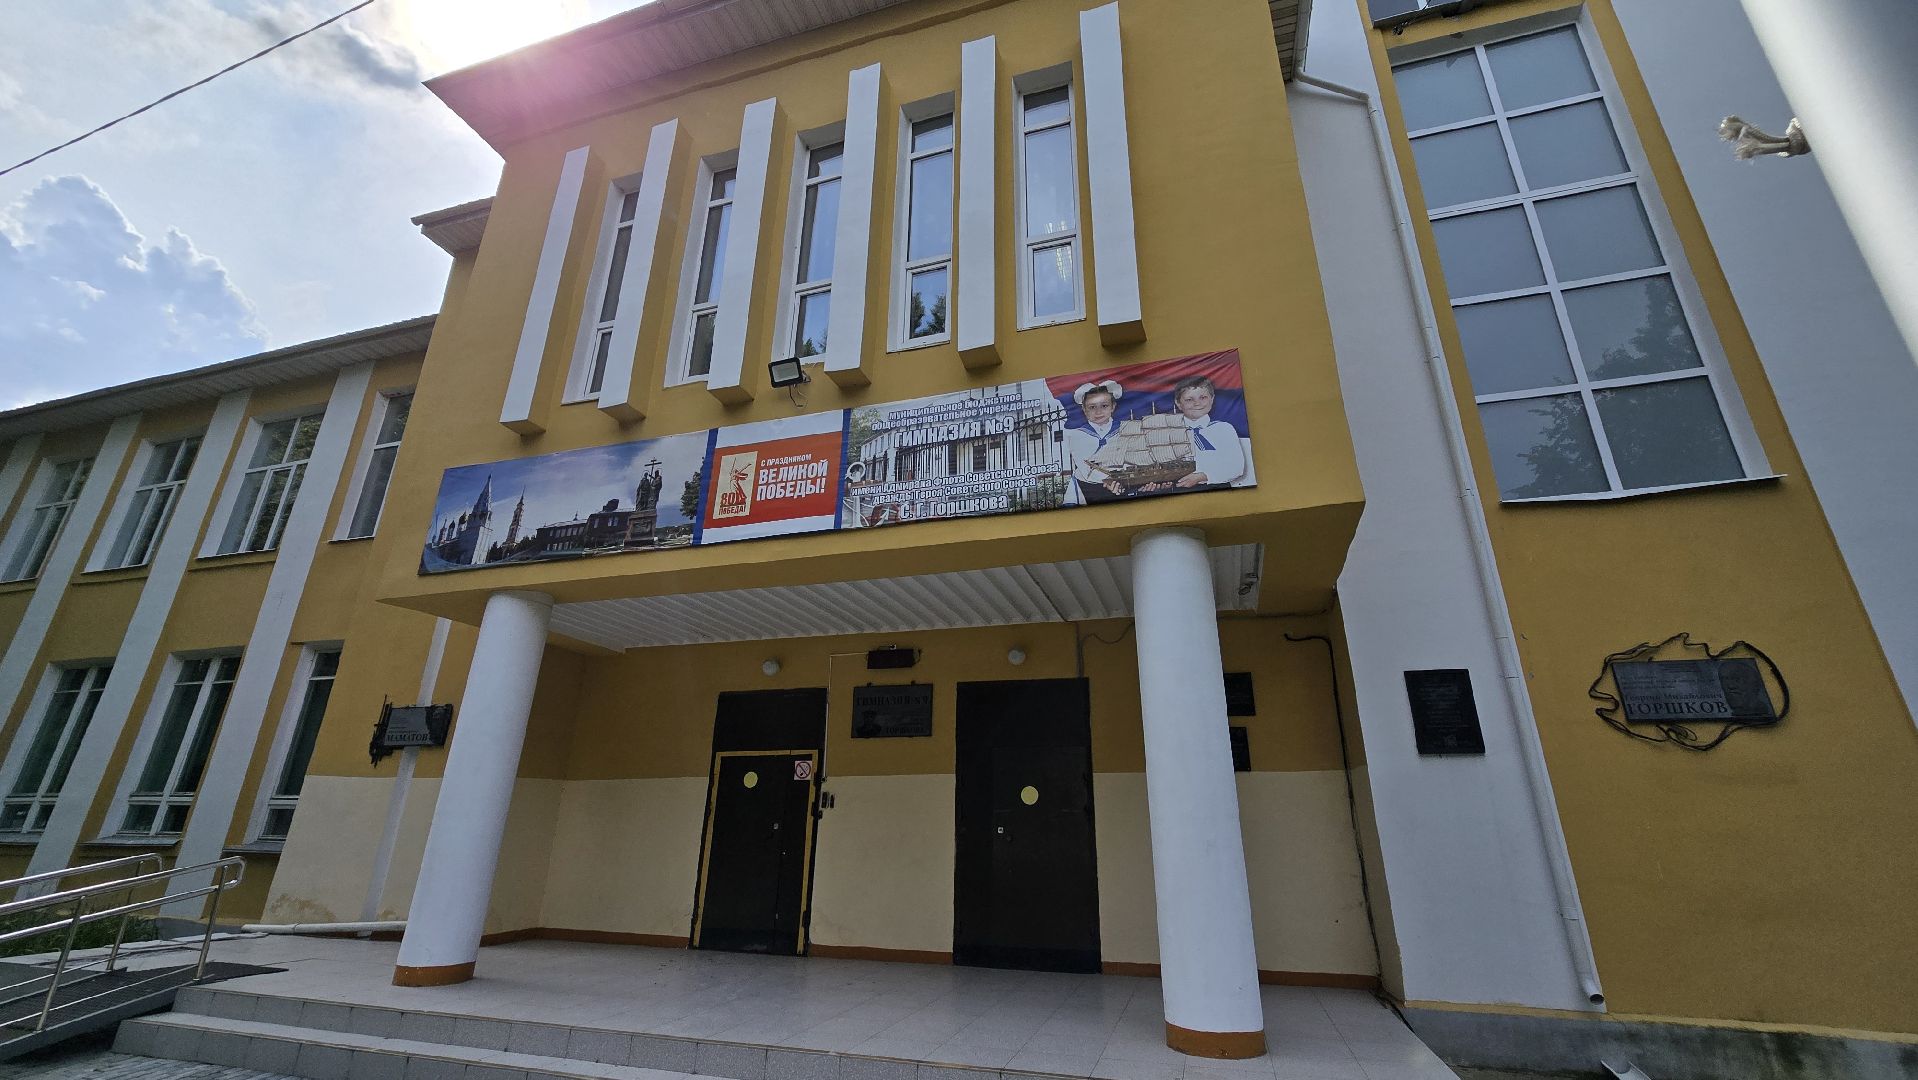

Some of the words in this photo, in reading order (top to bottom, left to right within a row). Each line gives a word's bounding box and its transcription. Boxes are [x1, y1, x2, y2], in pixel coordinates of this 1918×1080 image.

[979, 400, 1041, 416] учреждение
[894, 422, 981, 448] ГИМНАЗИЯ
[985, 416, 1015, 435] №9
[759, 459, 828, 484] ВЕЛИКОЙ
[852, 485, 882, 496] имени
[882, 479, 932, 493] Адмирала
[933, 475, 965, 487] Флота
[966, 467, 1023, 482] Советского
[756, 478, 826, 501] ПОБЕДЫ!
[873, 492, 914, 506] дважды
[915, 487, 943, 500] Героя
[944, 481, 1001, 496] Советского
[1002, 477, 1036, 489] Союза
[719, 504, 746, 515] ПОБЕДА!
[930, 495, 1008, 519] Горшкова
[1627, 701, 1728, 715] ГОРШКОВ
